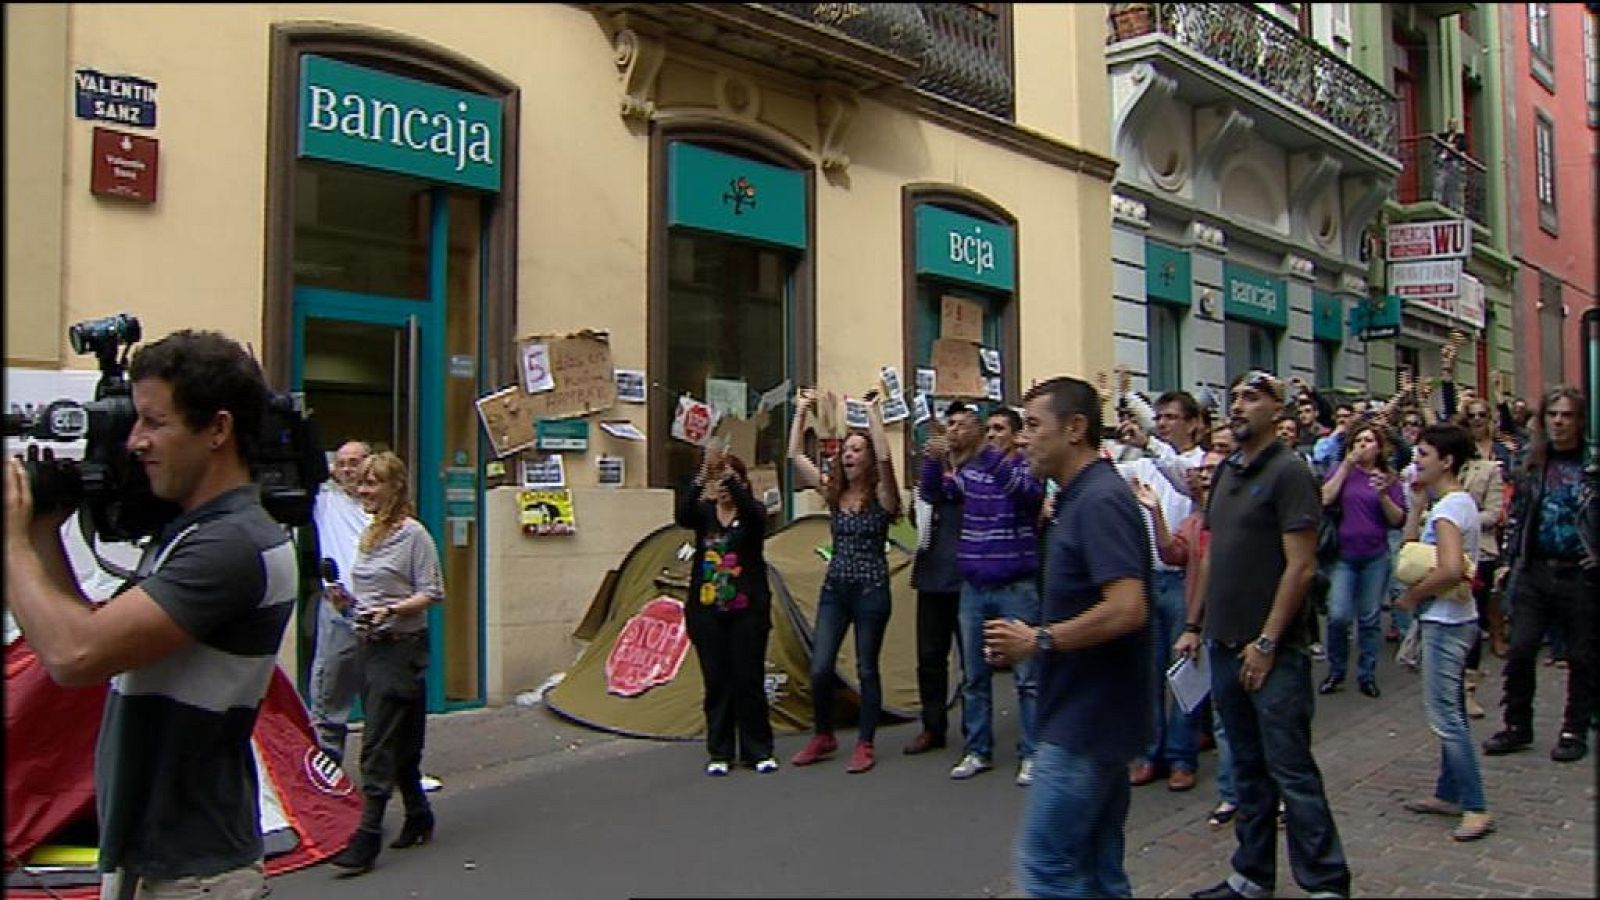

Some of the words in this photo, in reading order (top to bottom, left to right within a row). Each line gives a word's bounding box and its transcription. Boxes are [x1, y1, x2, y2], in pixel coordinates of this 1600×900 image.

[94, 101, 140, 123] SANZ
[308, 85, 493, 171] Bancaja
[1433, 223, 1464, 255] WU
[526, 350, 547, 385] 5
